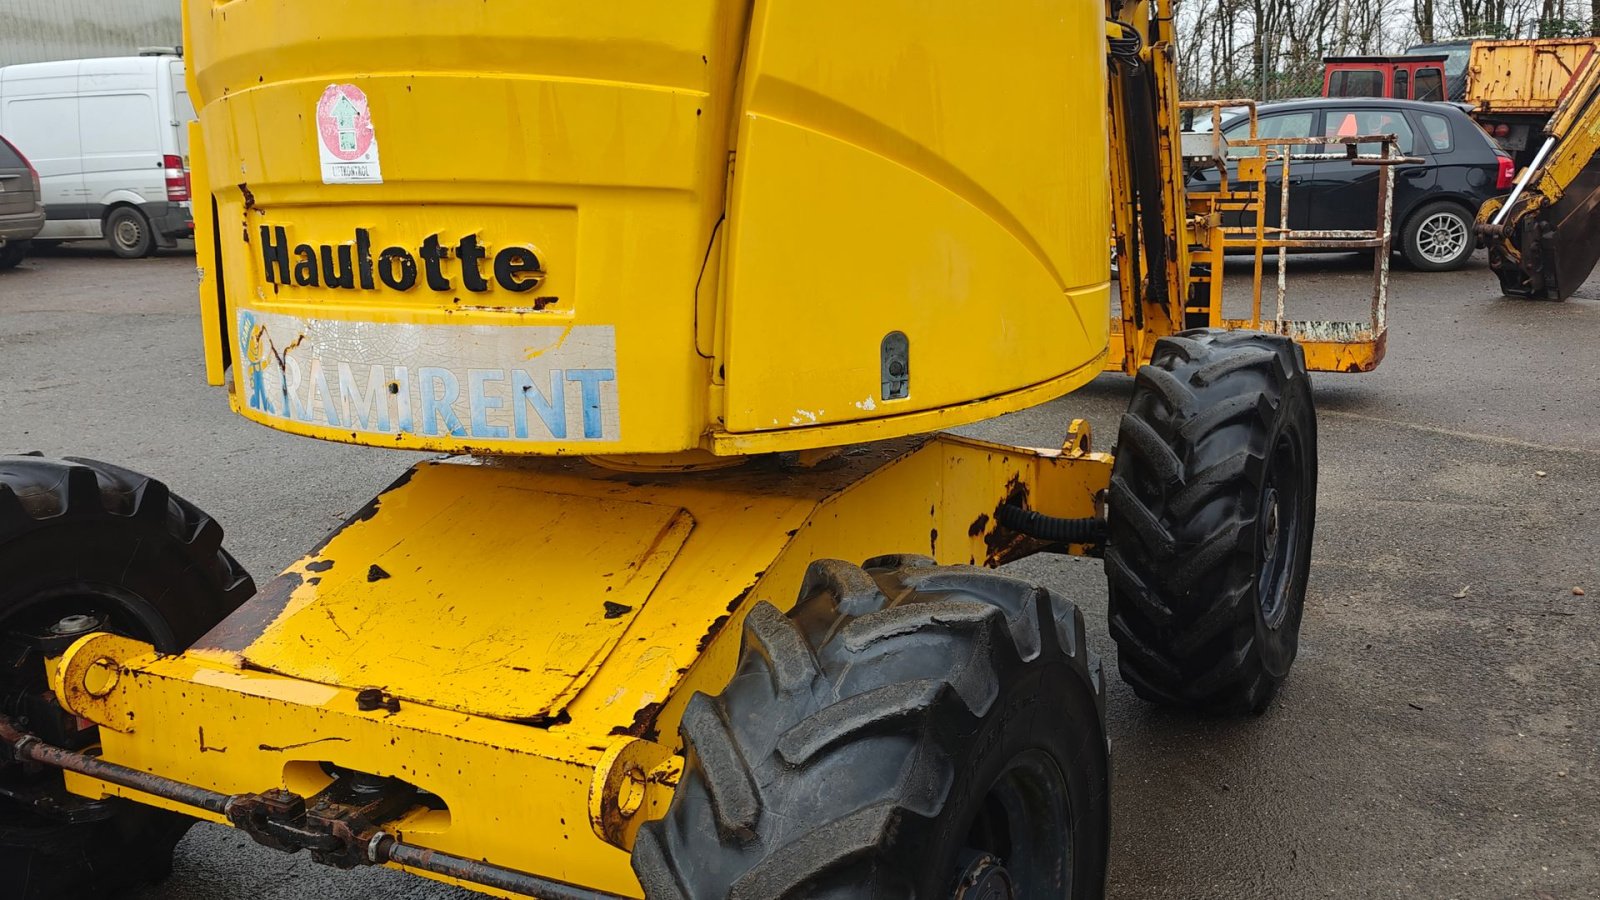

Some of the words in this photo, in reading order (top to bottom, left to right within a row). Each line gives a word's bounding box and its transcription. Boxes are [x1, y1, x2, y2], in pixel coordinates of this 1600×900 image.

[332, 165, 369, 176] LFTKONTROL
[260, 224, 546, 292] Haulotte
[279, 355, 615, 439] RAMIRENT
